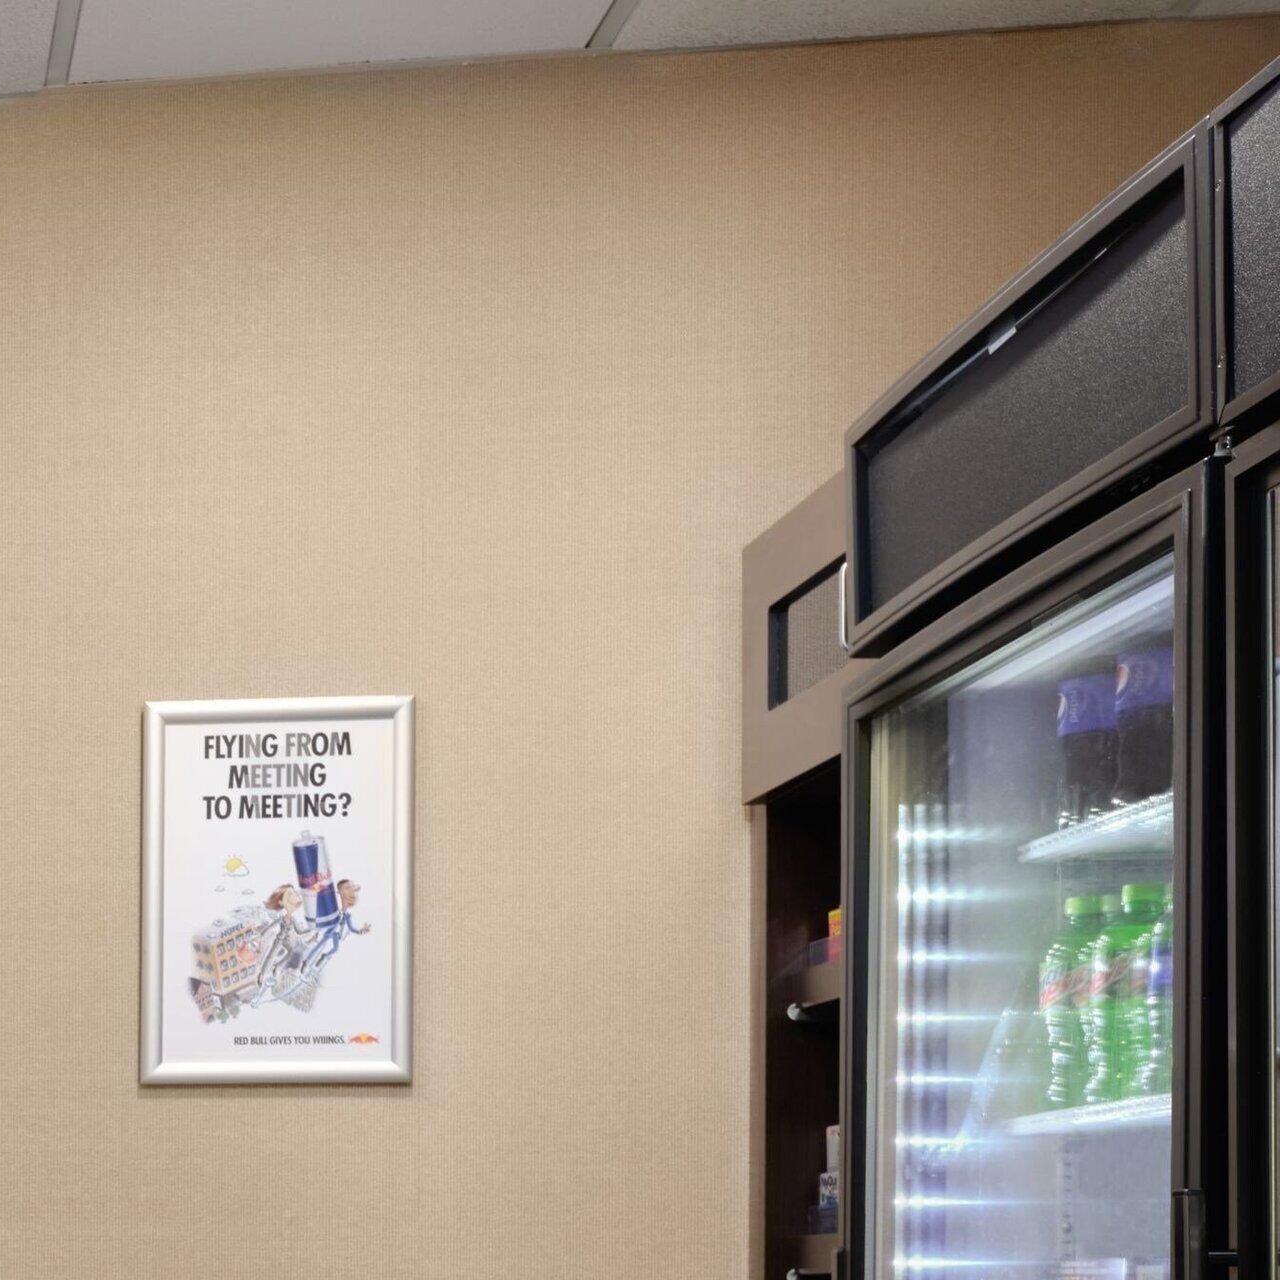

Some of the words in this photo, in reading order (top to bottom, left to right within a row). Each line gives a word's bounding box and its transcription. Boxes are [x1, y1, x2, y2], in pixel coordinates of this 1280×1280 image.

[204, 733, 278, 759] FLYING
[285, 731, 352, 757] FROM
[228, 762, 326, 789] MEETING
[203, 795, 232, 820] TO
[238, 792, 352, 820] MEETING?
[233, 1036, 249, 1046] RED
[250, 1036, 268, 1046] BULL
[269, 1036, 292, 1046] GIVES
[293, 1035, 311, 1045] YOU
